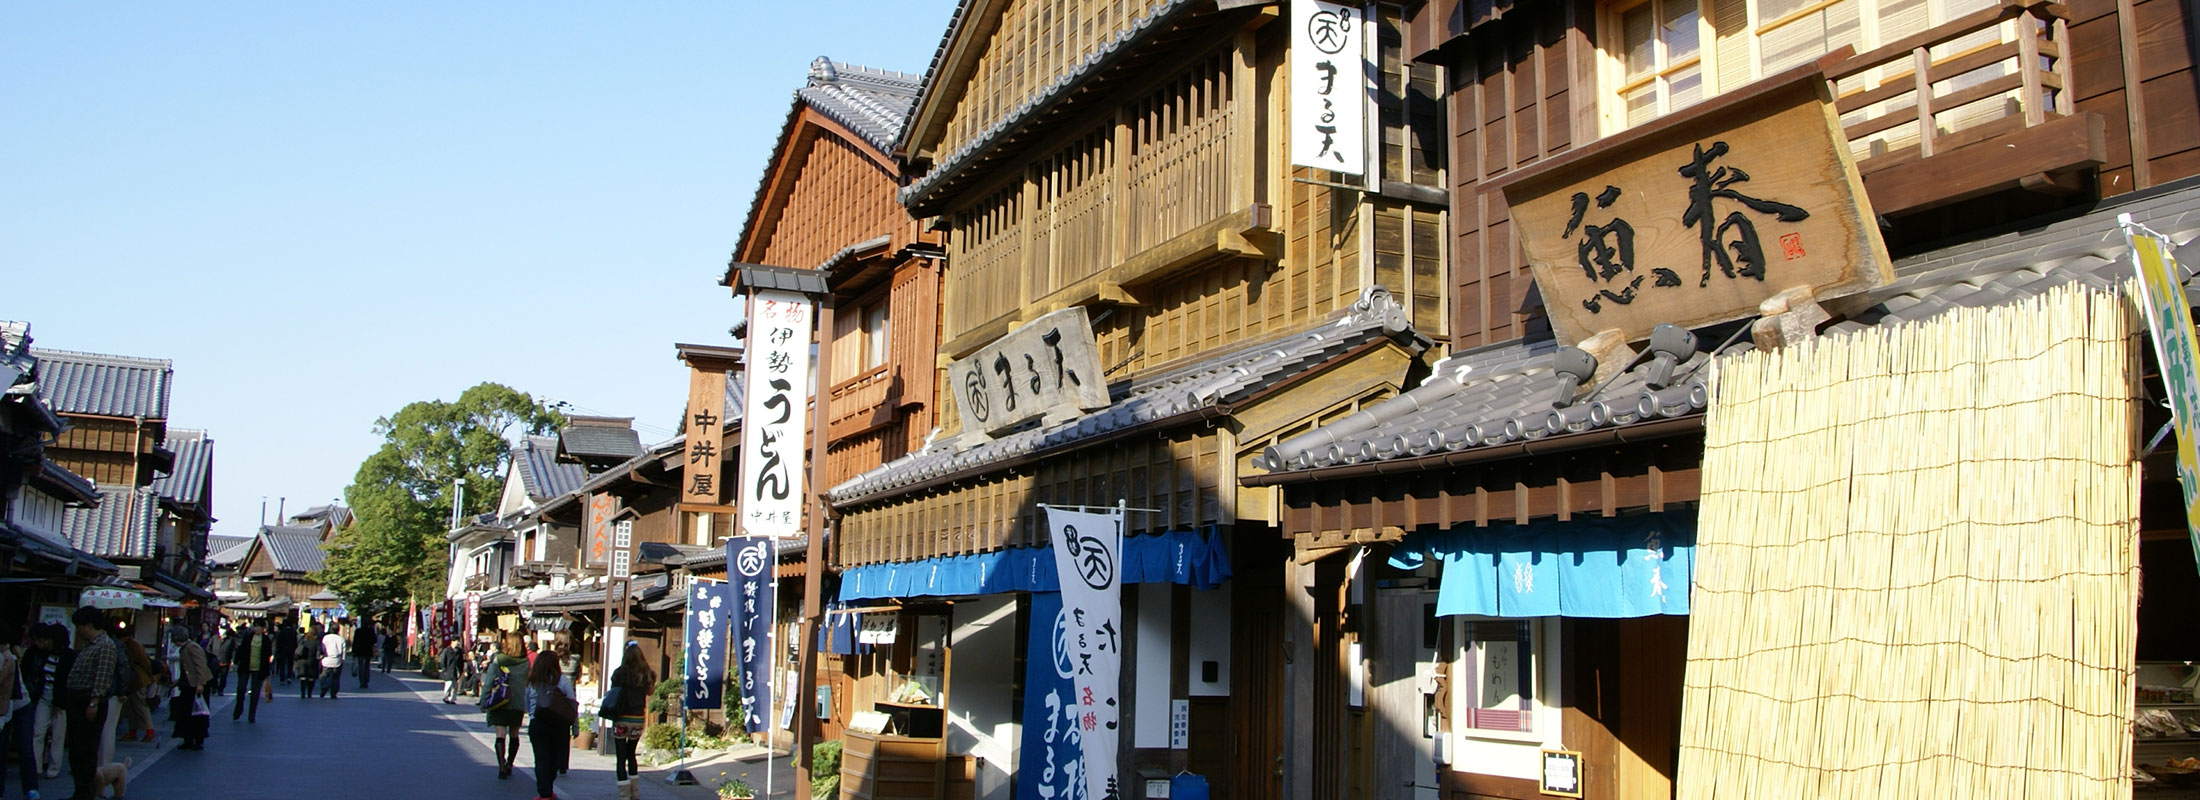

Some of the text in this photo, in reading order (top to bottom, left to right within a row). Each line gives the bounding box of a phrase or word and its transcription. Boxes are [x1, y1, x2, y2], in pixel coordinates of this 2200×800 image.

[1315, 59, 1345, 164] まる天
[1561, 140, 1811, 315] 魚春
[759, 299, 805, 325] 名物
[757, 326, 794, 502] 伊勢うどん
[994, 327, 1081, 413] まる天
[687, 408, 718, 497] 中井屋
[751, 509, 792, 526] 中井屋
